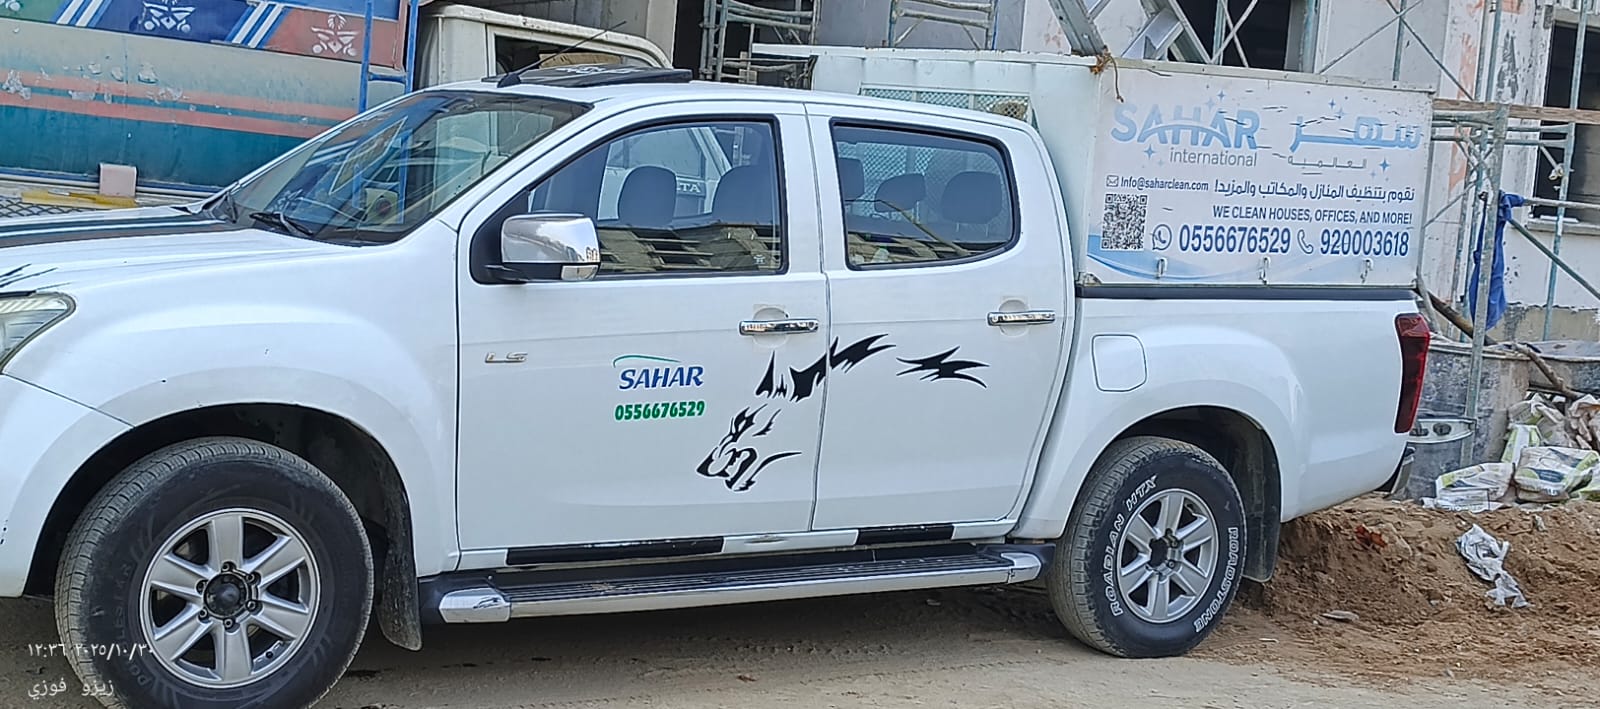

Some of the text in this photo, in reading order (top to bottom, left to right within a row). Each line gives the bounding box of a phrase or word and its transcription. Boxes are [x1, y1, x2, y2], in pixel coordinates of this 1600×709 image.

[1111, 103, 1260, 149] SAHAR
[1290, 115, 1421, 152] سهر
[1169, 147, 1257, 167] international
[1120, 175, 1209, 191] Info@saharclean.com
[1259, 181, 1308, 199] والمكاتب
[1310, 183, 1344, 200] المنازل
[1346, 184, 1386, 203] بتنظيف
[1388, 186, 1415, 203] نقوم
[1213, 205, 1412, 225] WE CLEAN HOUSES, OFFICES, AND MORE!
[1179, 224, 1291, 254] 0556676529
[1320, 228, 1409, 256] 920003618
[485, 352, 527, 363] LS
[619, 366, 704, 389] SAHAR
[615, 400, 705, 421] 0556676529
[1103, 473, 1157, 616] ROADIAN HTX
[1193, 527, 1239, 632] ROADSTONE
